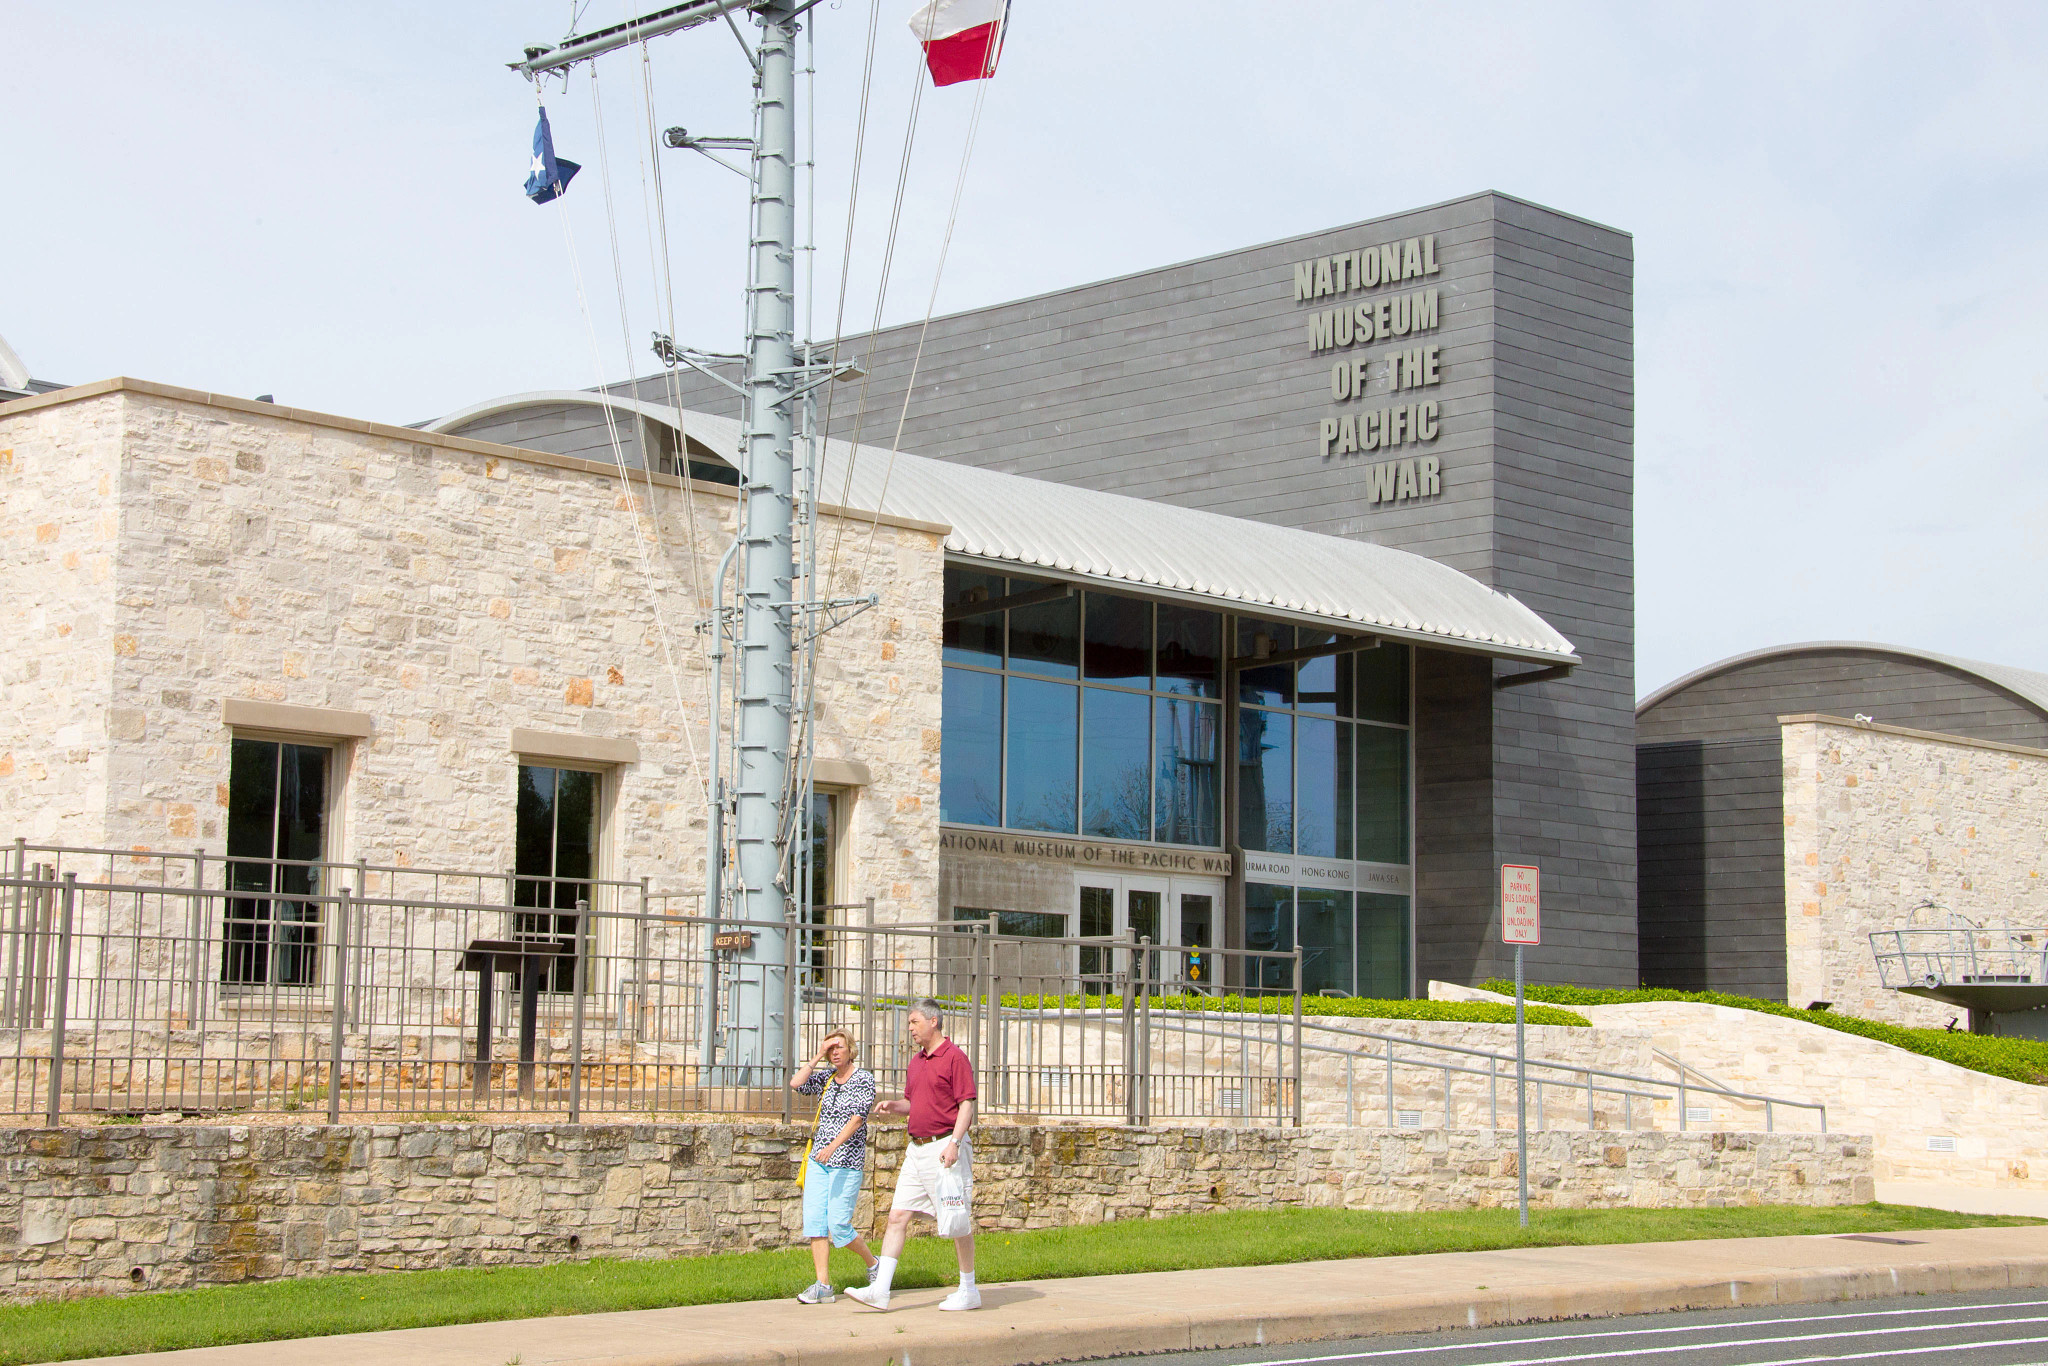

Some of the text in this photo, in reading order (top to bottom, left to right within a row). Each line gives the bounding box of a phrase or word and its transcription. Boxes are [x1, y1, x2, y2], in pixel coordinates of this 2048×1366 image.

[1294, 234, 1439, 302] NATIONAL
[1308, 288, 1439, 352] MUSEUM
[1331, 344, 1439, 400] OF THE
[1320, 400, 1438, 457] PACIFIC
[1366, 455, 1441, 504] WAR
[939, 833, 1231, 873] ATIONAL MUSEUM OF THE PACIFIC WAR
[1245, 861, 1290, 875] URMA ROAD
[1301, 867, 1350, 880] HONG KONG
[1368, 872, 1400, 884] JAVA SEA
[1517, 871, 1525, 880] NO
[1509, 882, 1531, 892] PARKING
[1505, 893, 1536, 904] BUS LOADING
[1516, 905, 1526, 914] AND
[1507, 917, 1535, 927] UNLOADING
[1515, 928, 1527, 938] ONLY
[715, 935, 747, 946] KEEP OF
